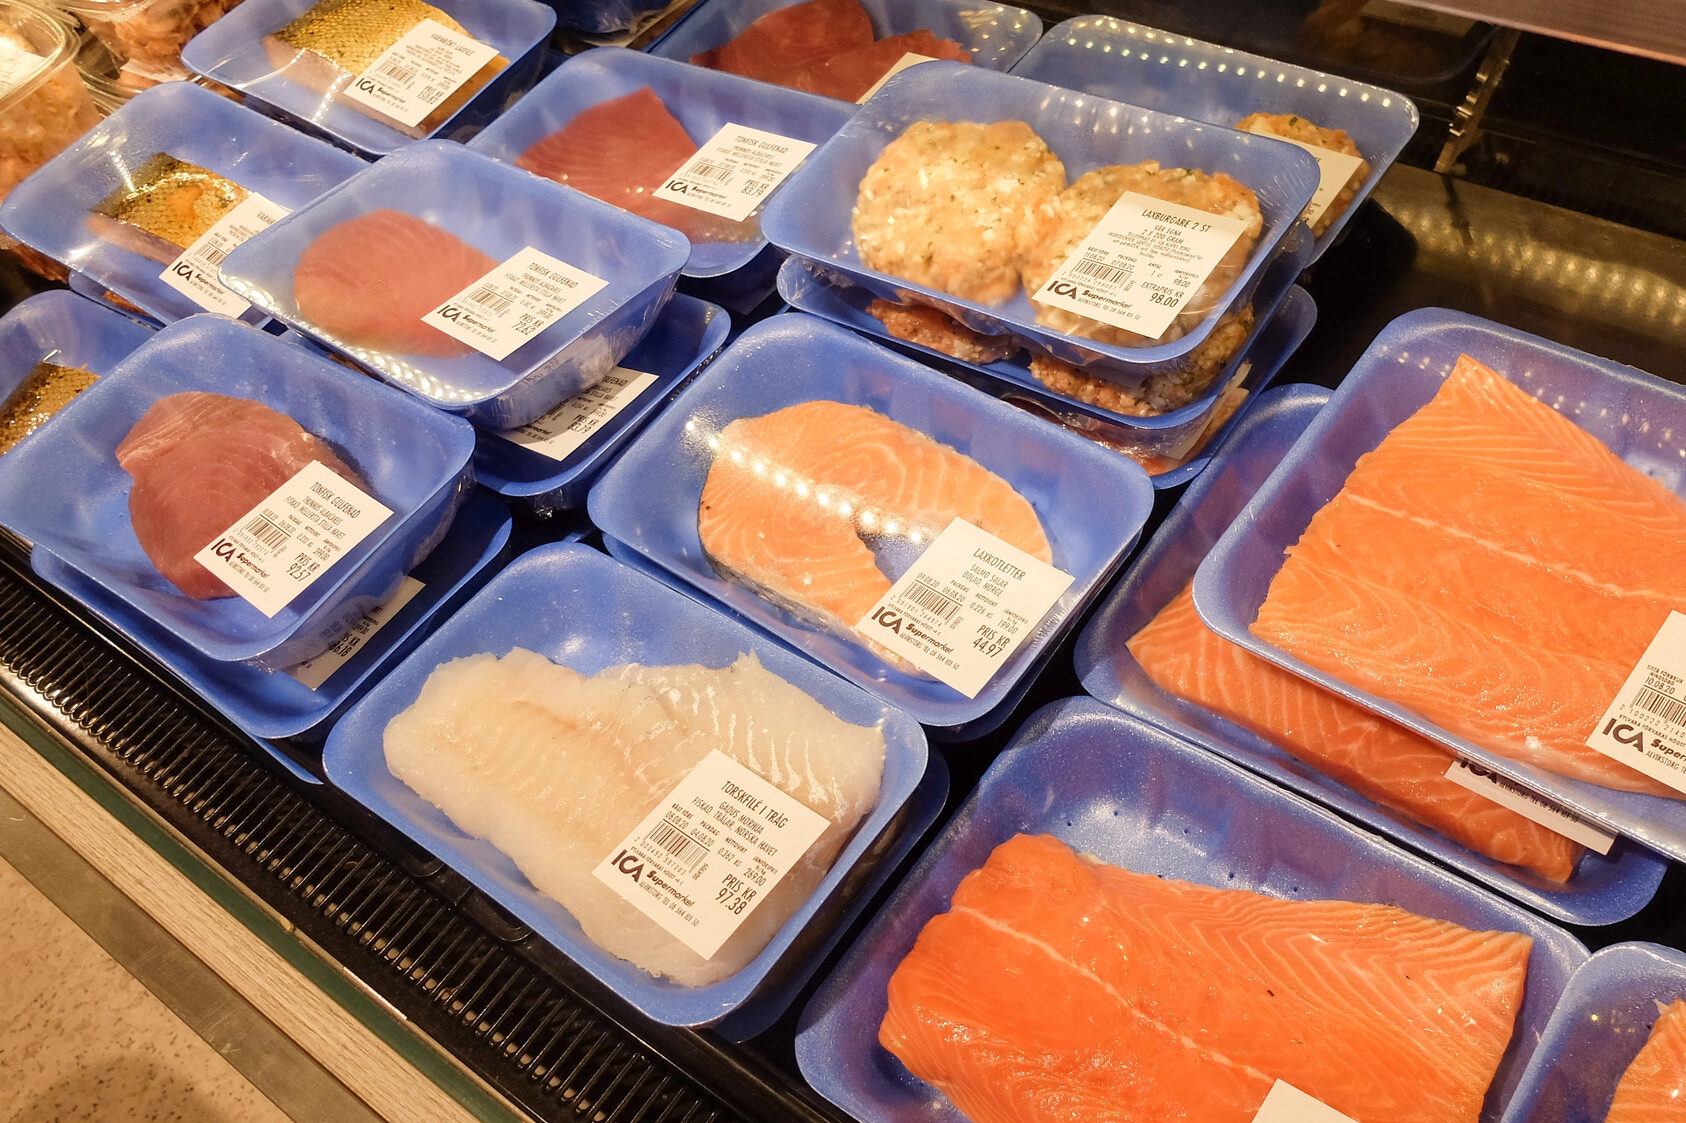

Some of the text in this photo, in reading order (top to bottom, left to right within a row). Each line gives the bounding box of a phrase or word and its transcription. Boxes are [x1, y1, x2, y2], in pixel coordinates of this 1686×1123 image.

[355, 78, 375, 94] ICA
[665, 180, 688, 194] ICA
[1142, 209, 1191, 227] LAXBURGARE
[172, 261, 193, 281] ICA
[1047, 281, 1077, 299] ICA
[1082, 290, 1132, 308] Supermarket
[1141, 281, 1174, 295] EXTRAPRIS
[1150, 292, 1179, 307] 98.00
[437, 305, 461, 322] ICA
[310, 482, 361, 518] TONFISK GULFENAD
[211, 538, 236, 562] ICA
[236, 552, 269, 577] Supermarket
[294, 552, 312, 566] PRIS
[307, 562, 320, 572] KR
[973, 548, 1026, 580] LAXKOTLETTER
[950, 580, 970, 593] PACKDAG
[970, 564, 1009, 589] SALMO SALAR
[983, 582, 1003, 597] NORGE
[969, 602, 986, 614] 0.226
[872, 606, 902, 634] ICA
[906, 623, 953, 653] Supermarket
[977, 624, 998, 640] PRIS
[995, 635, 1010, 648] KR
[997, 619, 1018, 634] 199.00
[973, 637, 1003, 658] 44.97
[1645, 676, 1675, 695] 10.08.20
[1603, 718, 1643, 752] ICA
[1646, 750, 1679, 770] ALVIKSTORG
[722, 781, 788, 828] TORSKFILÉ I TRÅG
[692, 797, 778, 856] FISKAD, TRÅLAR, NORSKA HAVET
[719, 801, 764, 834] GADUS MORHUA
[700, 820, 720, 836] PACKDAG
[717, 847, 735, 862] 0.362
[725, 837, 747, 853] NETTOVIKT
[611, 850, 644, 882] ICA
[647, 870, 694, 906] Supermarket
[743, 868, 766, 886] 269.00
[722, 874, 744, 893] PRIS
[741, 887, 757, 902] KR
[715, 888, 747, 915] 97.38
